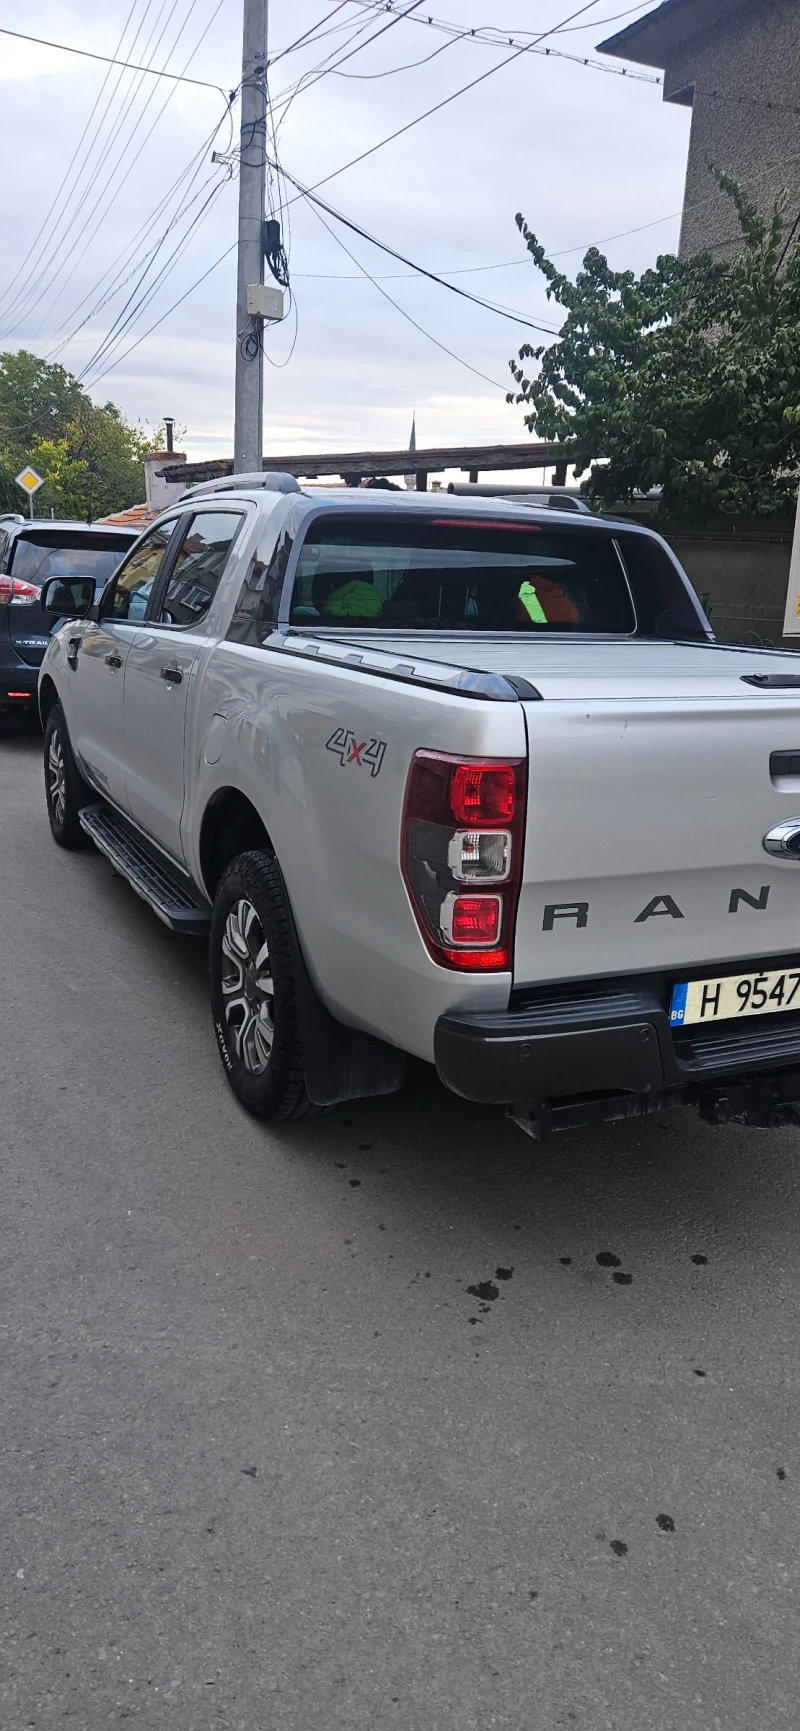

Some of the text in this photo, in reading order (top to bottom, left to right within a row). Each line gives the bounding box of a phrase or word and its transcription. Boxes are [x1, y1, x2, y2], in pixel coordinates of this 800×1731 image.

[541, 885, 771, 931] RAN
[671, 1009, 684, 1021] BG
[700, 972, 800, 1018] H 9547
